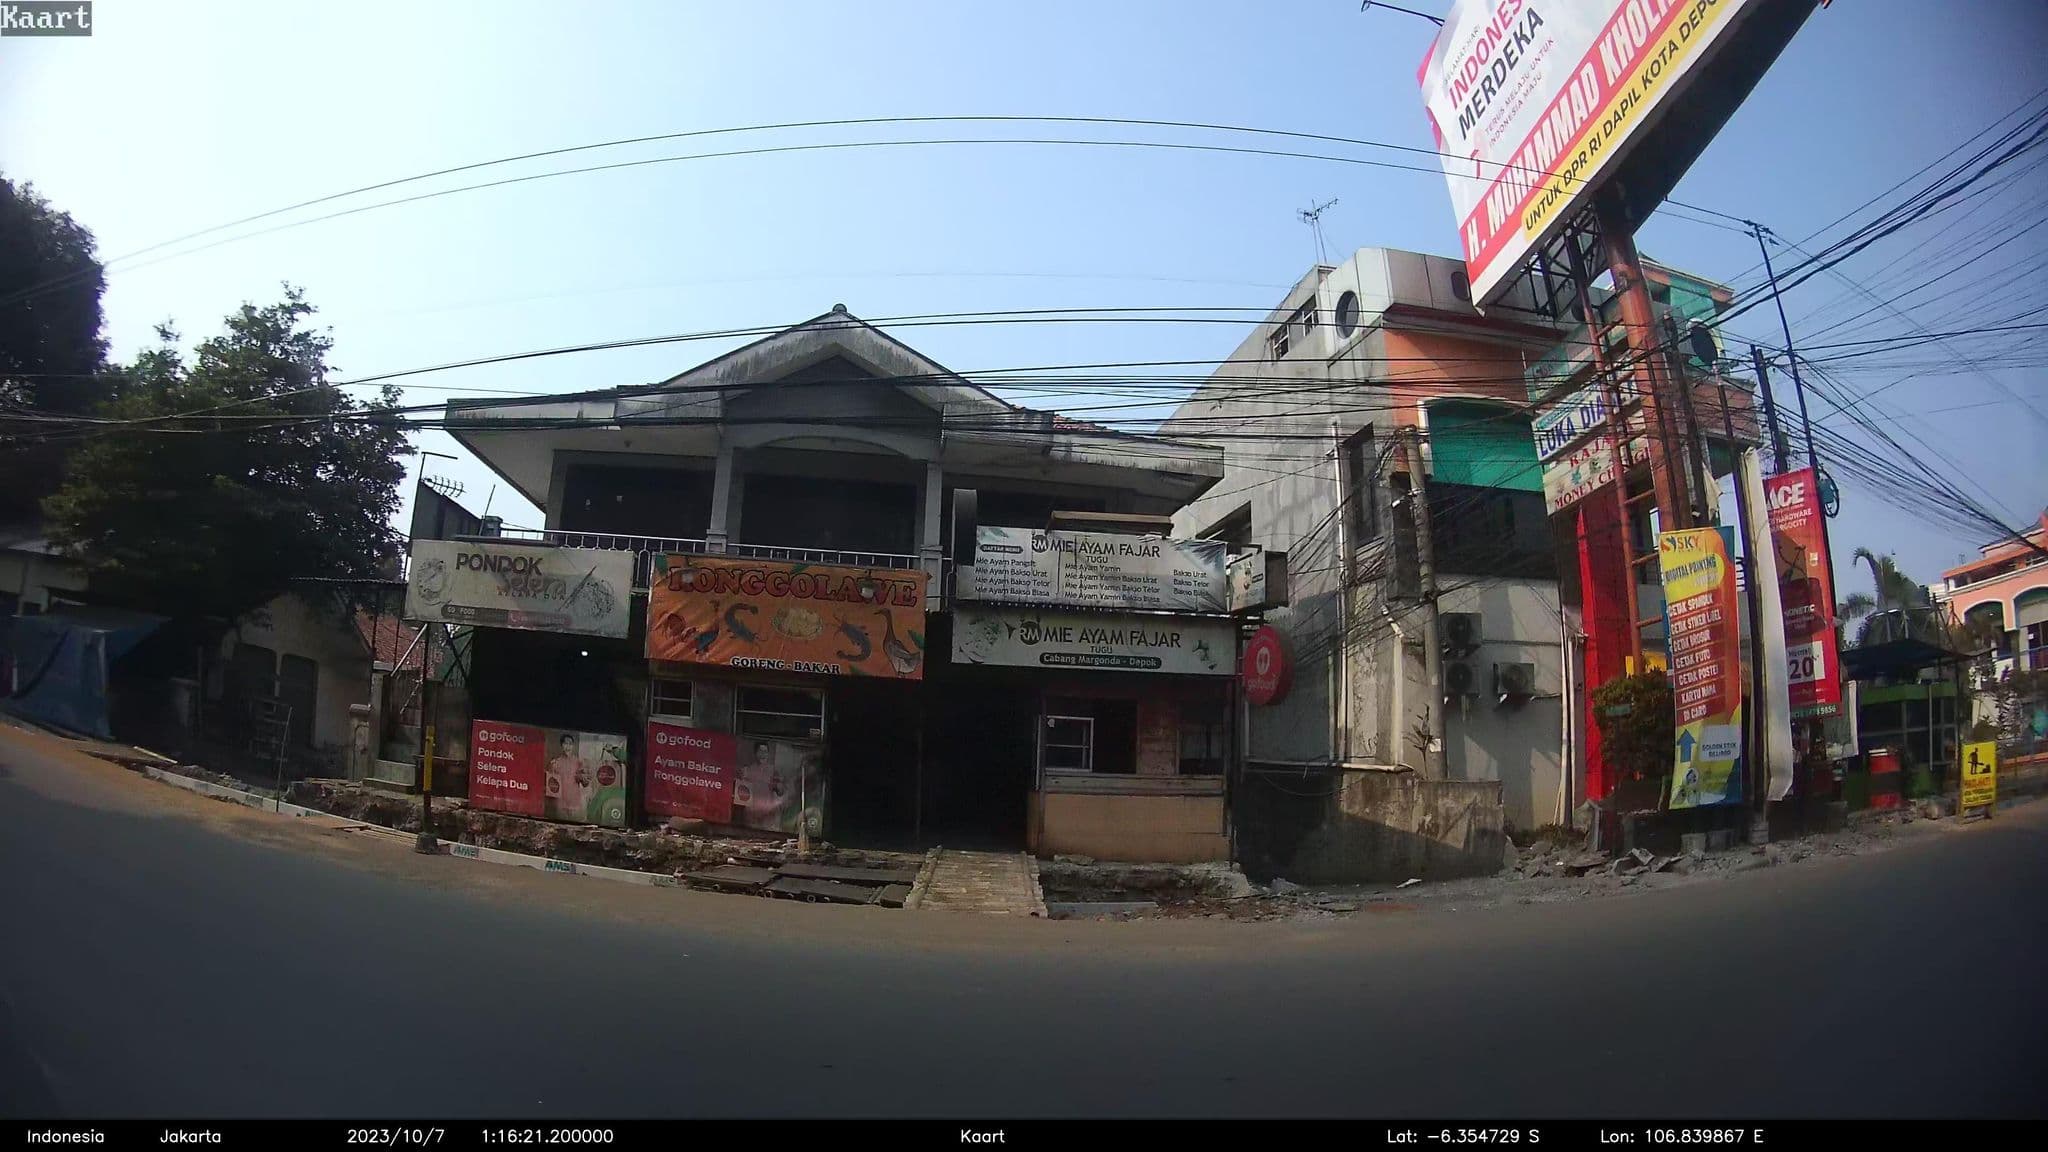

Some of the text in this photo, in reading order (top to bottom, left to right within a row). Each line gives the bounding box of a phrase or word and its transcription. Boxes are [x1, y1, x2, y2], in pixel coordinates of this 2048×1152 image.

[1458, 7, 1544, 141] MERDEKA
[1505, 73, 1530, 106] MELAJU
[1530, 38, 1554, 71] UNTUK
[1522, 72, 1542, 99] MAJU
[1525, 179, 1562, 231] UNTUK
[1563, 149, 1588, 187] DPR
[1588, 132, 1602, 156] RI
[1602, 88, 1642, 139] DAPIL
[1641, 39, 1679, 91] KOTA
[1466, 217, 1487, 264] H.
[1486, 62, 1600, 239] MUHAMMAD
[1539, 416, 1576, 457] LUKA
[1555, 481, 1594, 510] MONEY
[1763, 482, 1805, 512] ACE
[1050, 539, 1074, 553] MIE
[1079, 540, 1115, 555] AYAM
[1119, 543, 1160, 557] FAJAR
[1677, 535, 1699, 550] SKY
[455, 552, 544, 577] PONDOK
[989, 558, 1009, 567] Ayam
[1086, 555, 1109, 564] TUGU
[989, 567, 1009, 577] Ayam
[1011, 568, 1031, 576] Bakso
[1079, 563, 1098, 572] Ayam
[989, 577, 1009, 585] Ayam
[1079, 573, 1098, 581] Ayam
[989, 587, 1008, 595] Ayam
[1079, 582, 1098, 591] Ayam
[1079, 592, 1098, 600] Ayam
[1043, 626, 1073, 643] MIE
[1078, 627, 1124, 645] AYAM
[1130, 630, 1181, 648] FAJAR
[1090, 646, 1112, 654] TUGU
[730, 656, 785, 671] GORENG
[794, 661, 841, 675] BAKAR
[1044, 653, 1076, 665] Cabang
[1078, 655, 1121, 665] Margonda
[1129, 658, 1157, 667] Depok
[490, 731, 525, 745] gofood
[669, 734, 712, 749] gofood
[478, 747, 514, 761] Pondok
[477, 761, 507, 774] Selera
[654, 755, 722, 775] Ayam Bakar
[476, 775, 529, 791] Kelapa Dua
[654, 769, 723, 790] Ronggolawe
